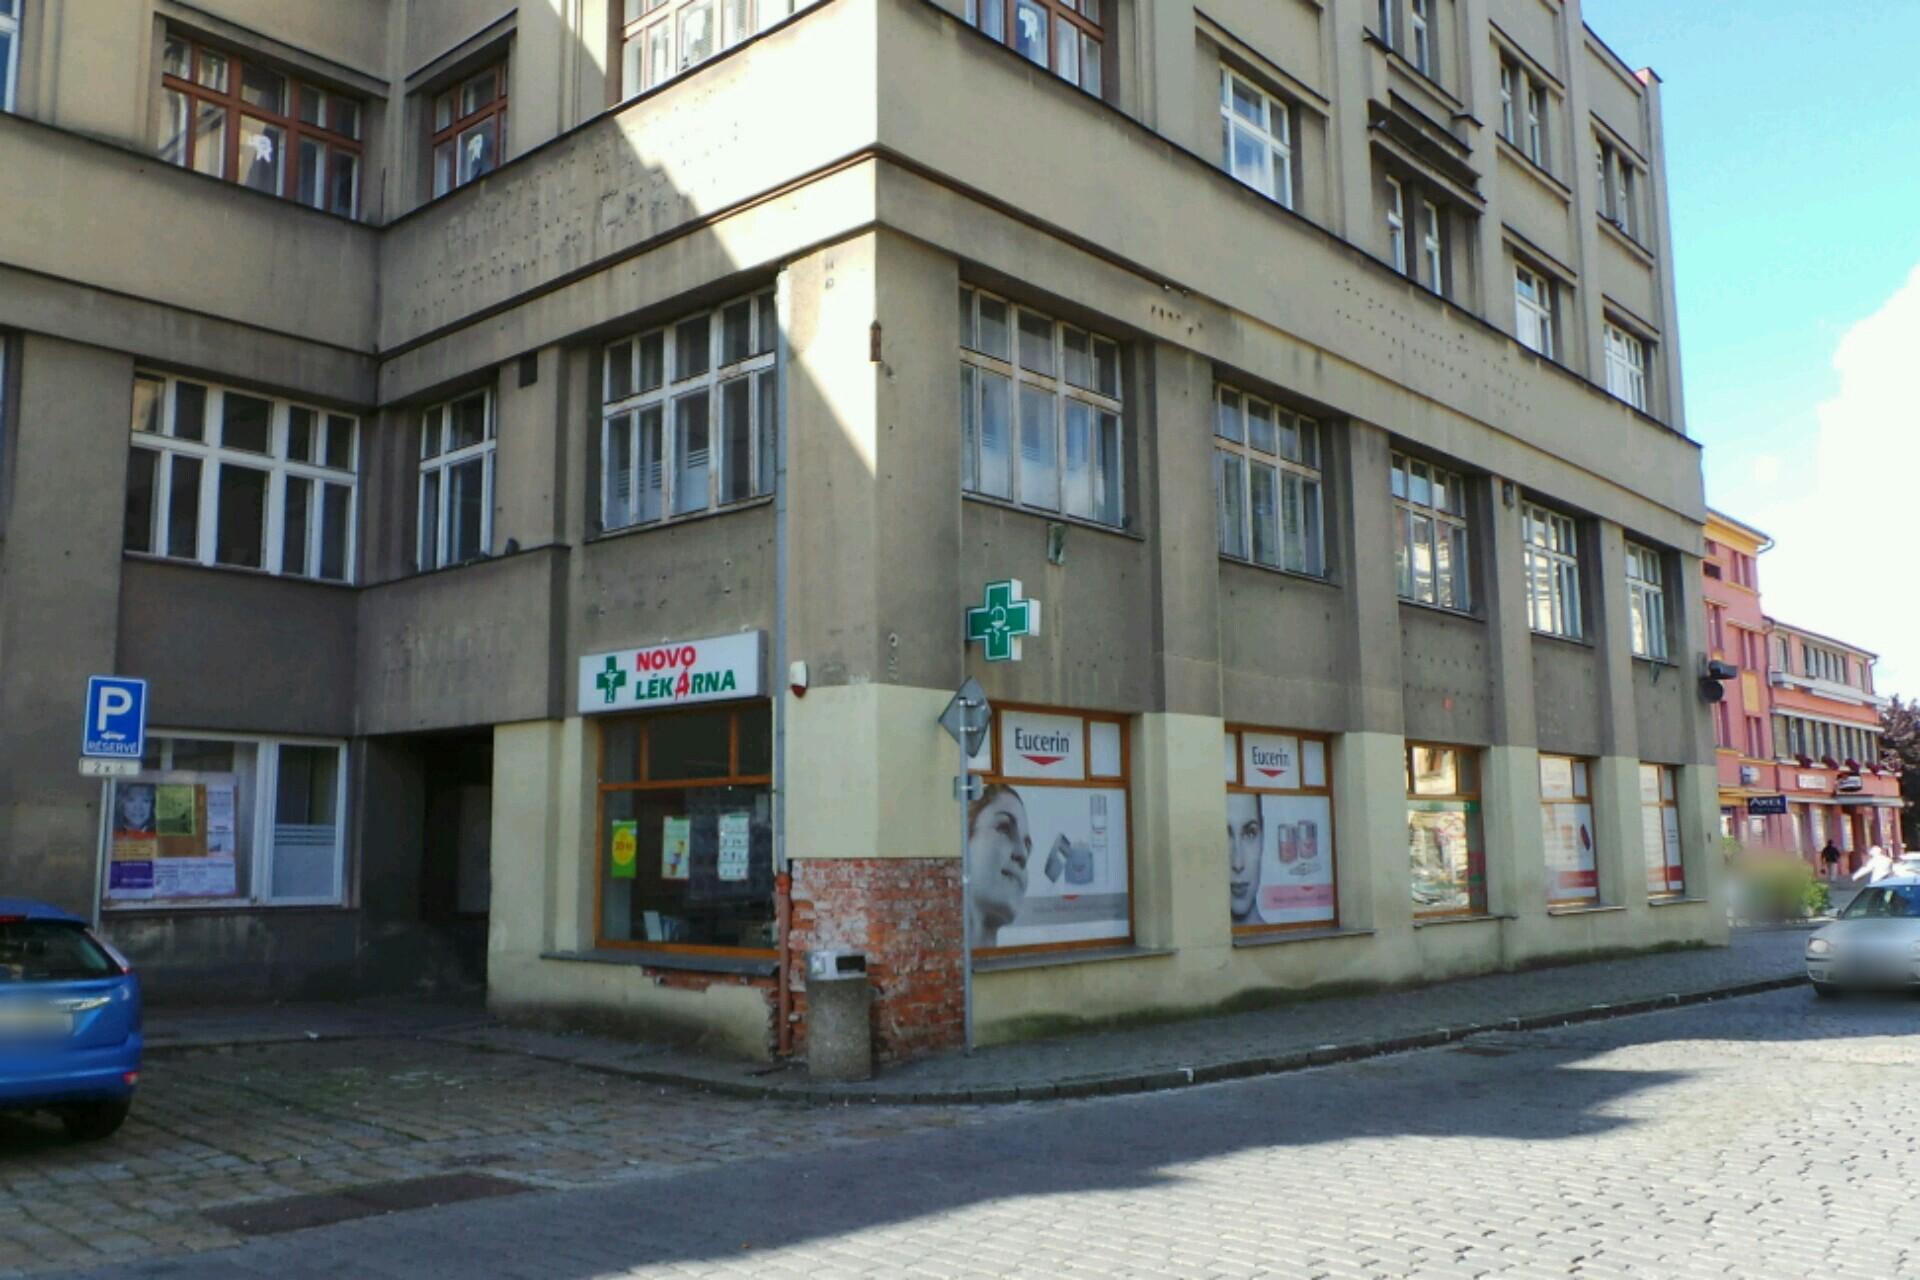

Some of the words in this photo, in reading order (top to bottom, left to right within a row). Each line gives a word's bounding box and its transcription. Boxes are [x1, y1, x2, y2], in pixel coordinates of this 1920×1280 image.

[636, 646, 696, 672] NOVO
[97, 686, 133, 731] P
[1014, 727, 1070, 752] Eucerin
[1251, 745, 1290, 767] Eucerin
